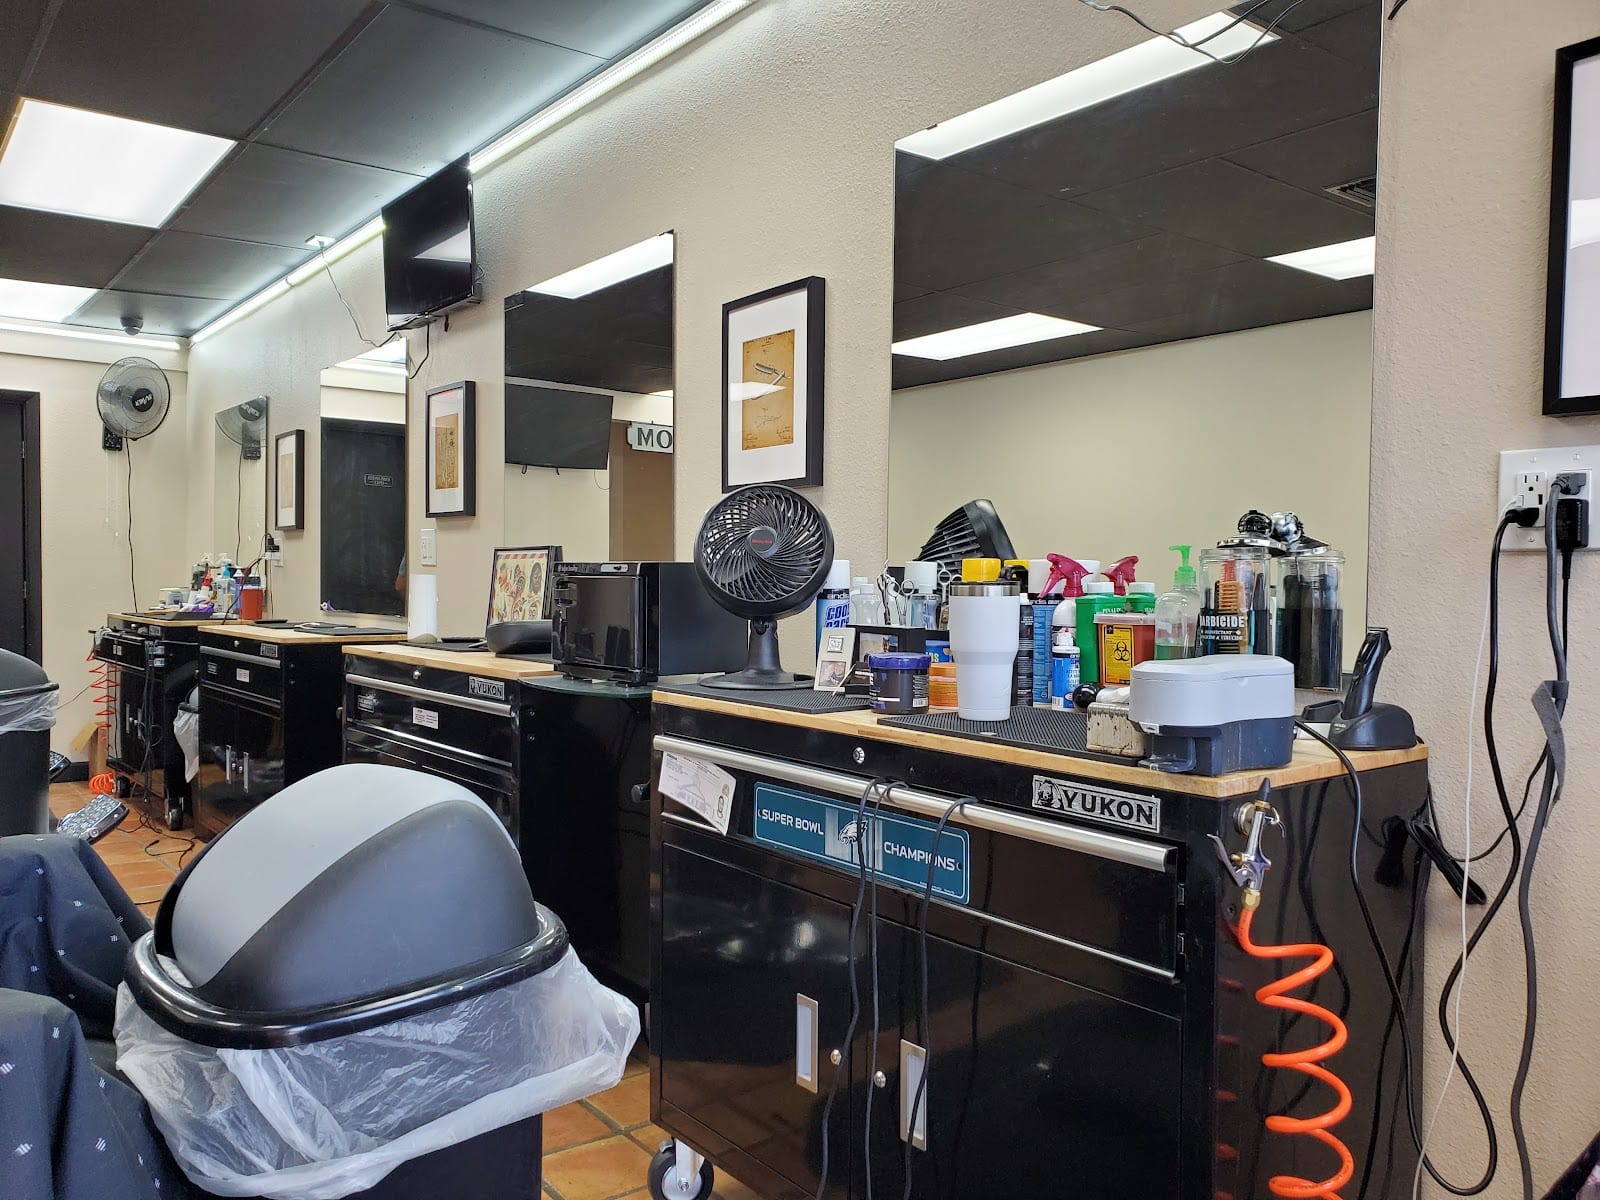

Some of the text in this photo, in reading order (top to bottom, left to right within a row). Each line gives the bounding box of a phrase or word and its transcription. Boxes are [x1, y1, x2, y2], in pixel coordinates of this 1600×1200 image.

[477, 683, 503, 697] YUKON
[1062, 788, 1154, 826] YUKON
[761, 808, 794, 829] SUPER
[795, 816, 825, 836] BOWL
